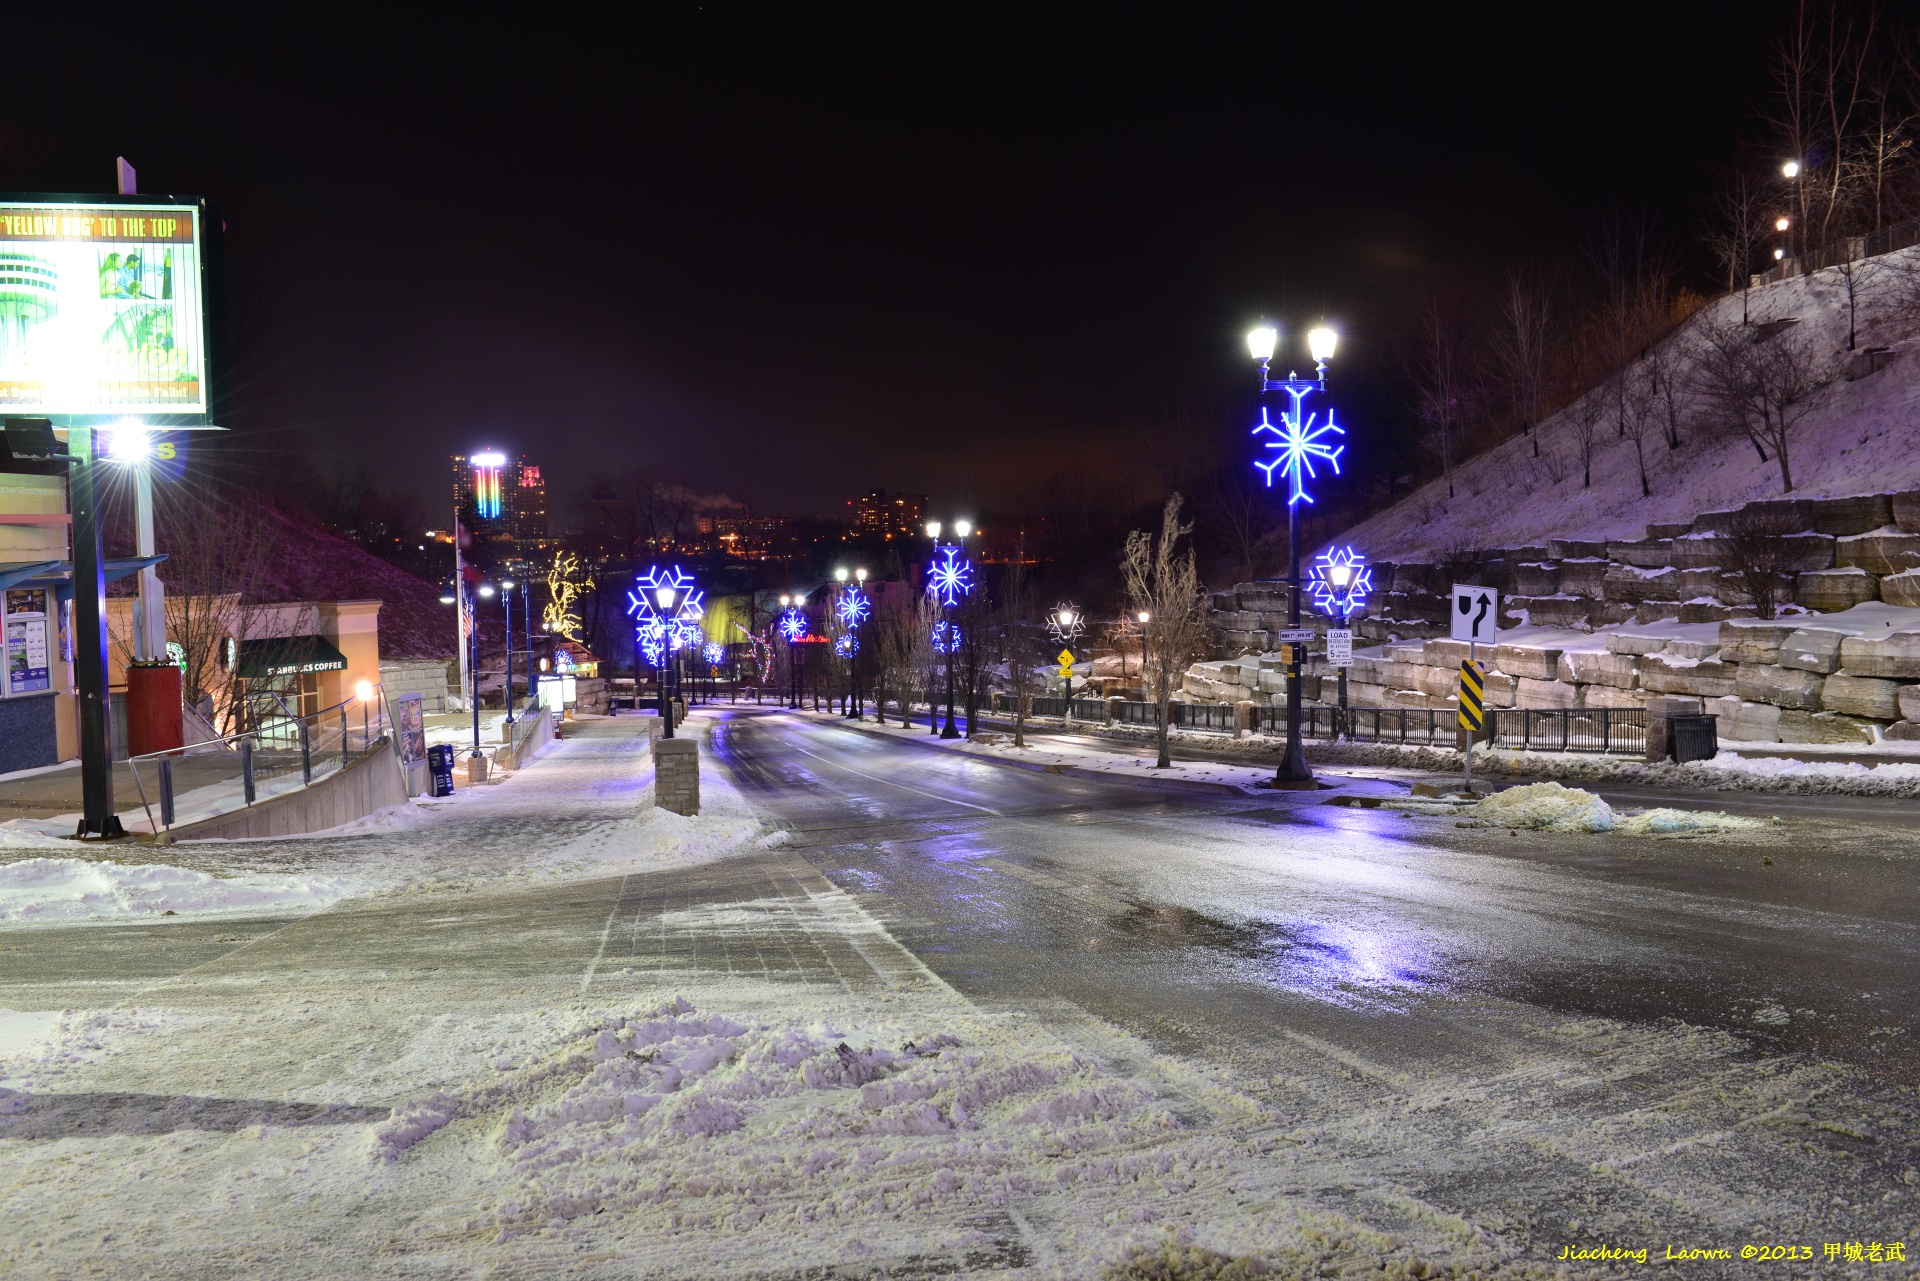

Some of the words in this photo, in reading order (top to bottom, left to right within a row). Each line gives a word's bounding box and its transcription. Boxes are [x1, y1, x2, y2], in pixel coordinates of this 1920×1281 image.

[100, 217, 117, 237] TO
[121, 218, 146, 238] THE
[150, 218, 177, 238] TOP
[154, 387, 187, 398] Falls!
[1330, 650, 1335, 658] 5
[314, 661, 342, 671] COFFEE
